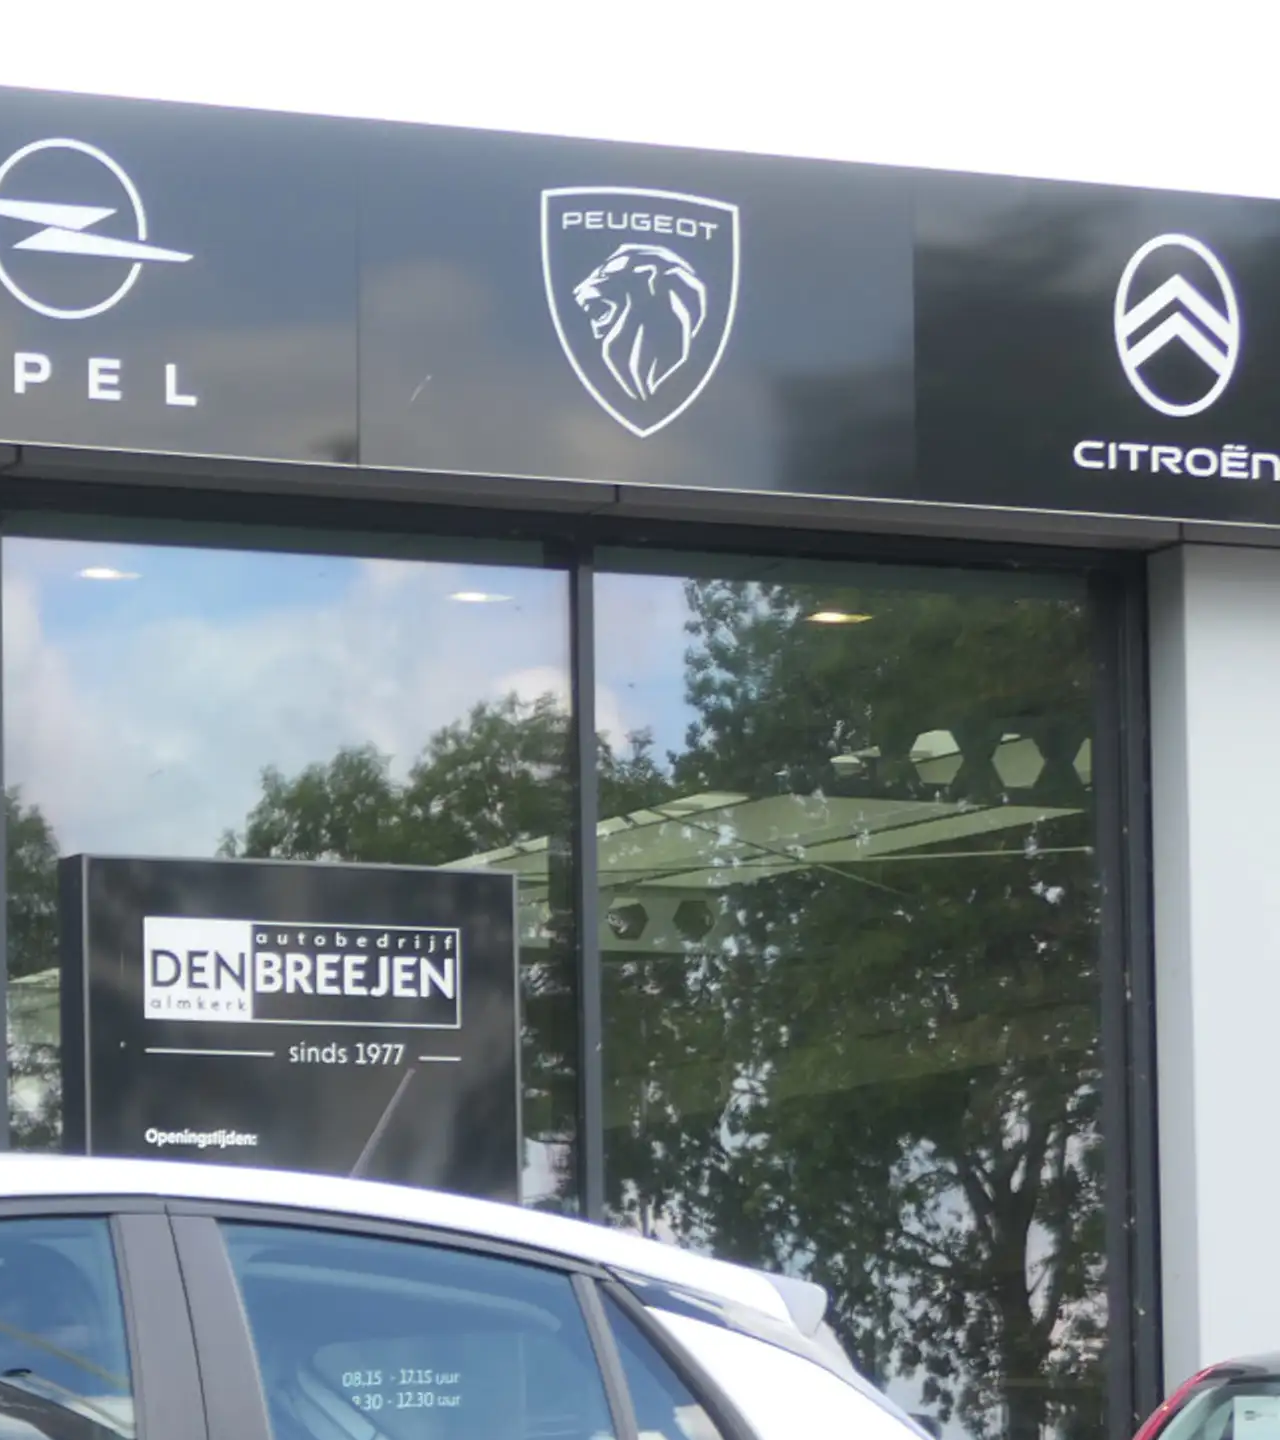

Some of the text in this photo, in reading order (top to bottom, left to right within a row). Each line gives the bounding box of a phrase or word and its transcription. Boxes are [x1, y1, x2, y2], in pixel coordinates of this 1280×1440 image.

[562, 211, 719, 241] PEUGEOT
[255, 931, 453, 953] autobedrijf
[149, 949, 456, 999] DEN BREEJEN
[149, 996, 248, 1012] almkerk
[289, 1041, 406, 1065] sinds 1977
[144, 1128, 258, 1149] Openingstijden:
